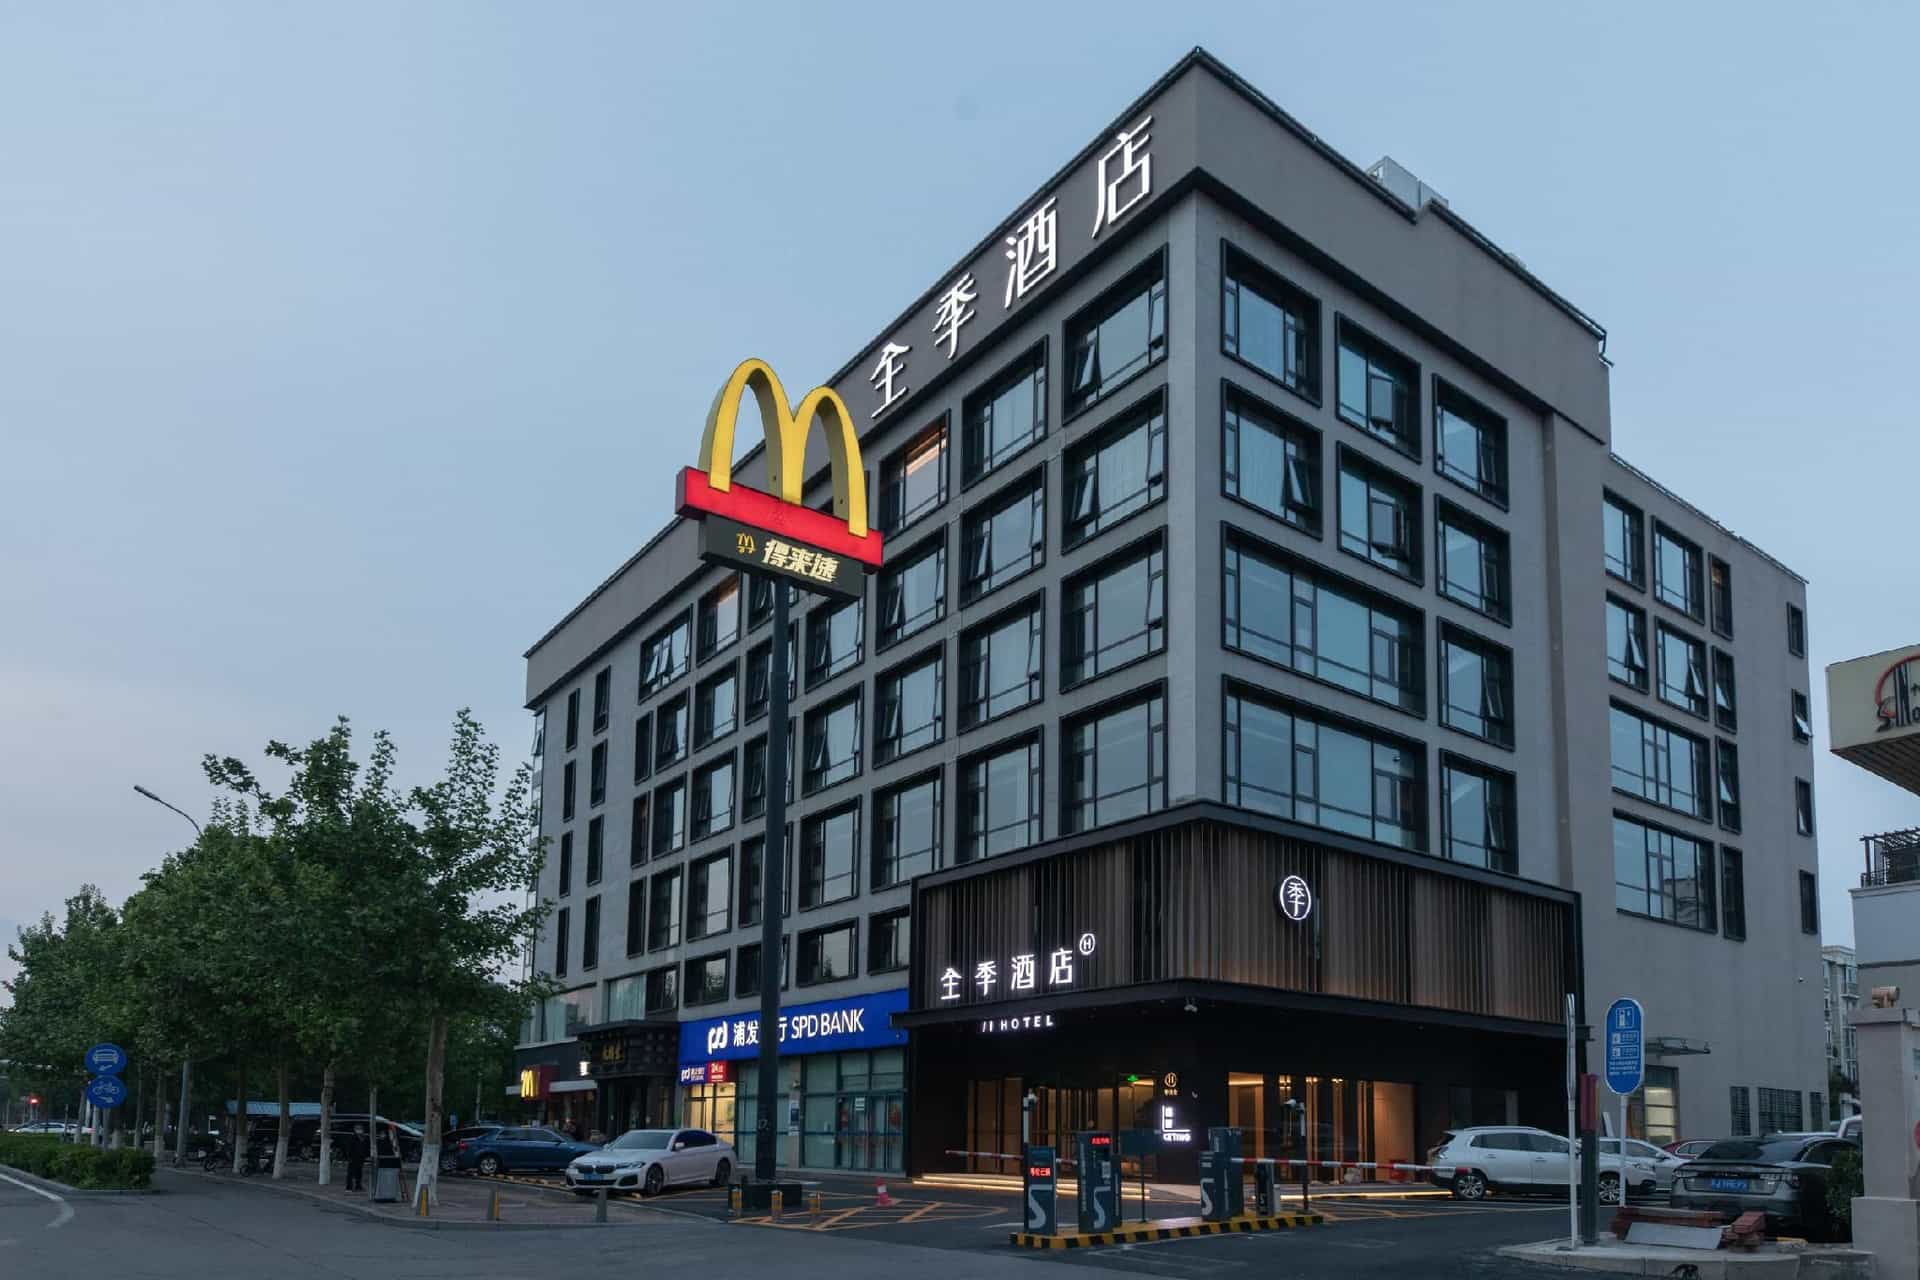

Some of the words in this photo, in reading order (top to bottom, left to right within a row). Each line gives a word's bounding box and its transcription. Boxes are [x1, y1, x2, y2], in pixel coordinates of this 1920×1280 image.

[869, 115, 1152, 418] 全季酒店
[761, 538, 840, 582] 得来速
[940, 947, 1073, 1000] 全季酒店
[791, 1014, 818, 1040] SPD
[820, 1007, 865, 1036] BANK
[1000, 1015, 1054, 1032] HOTEL
